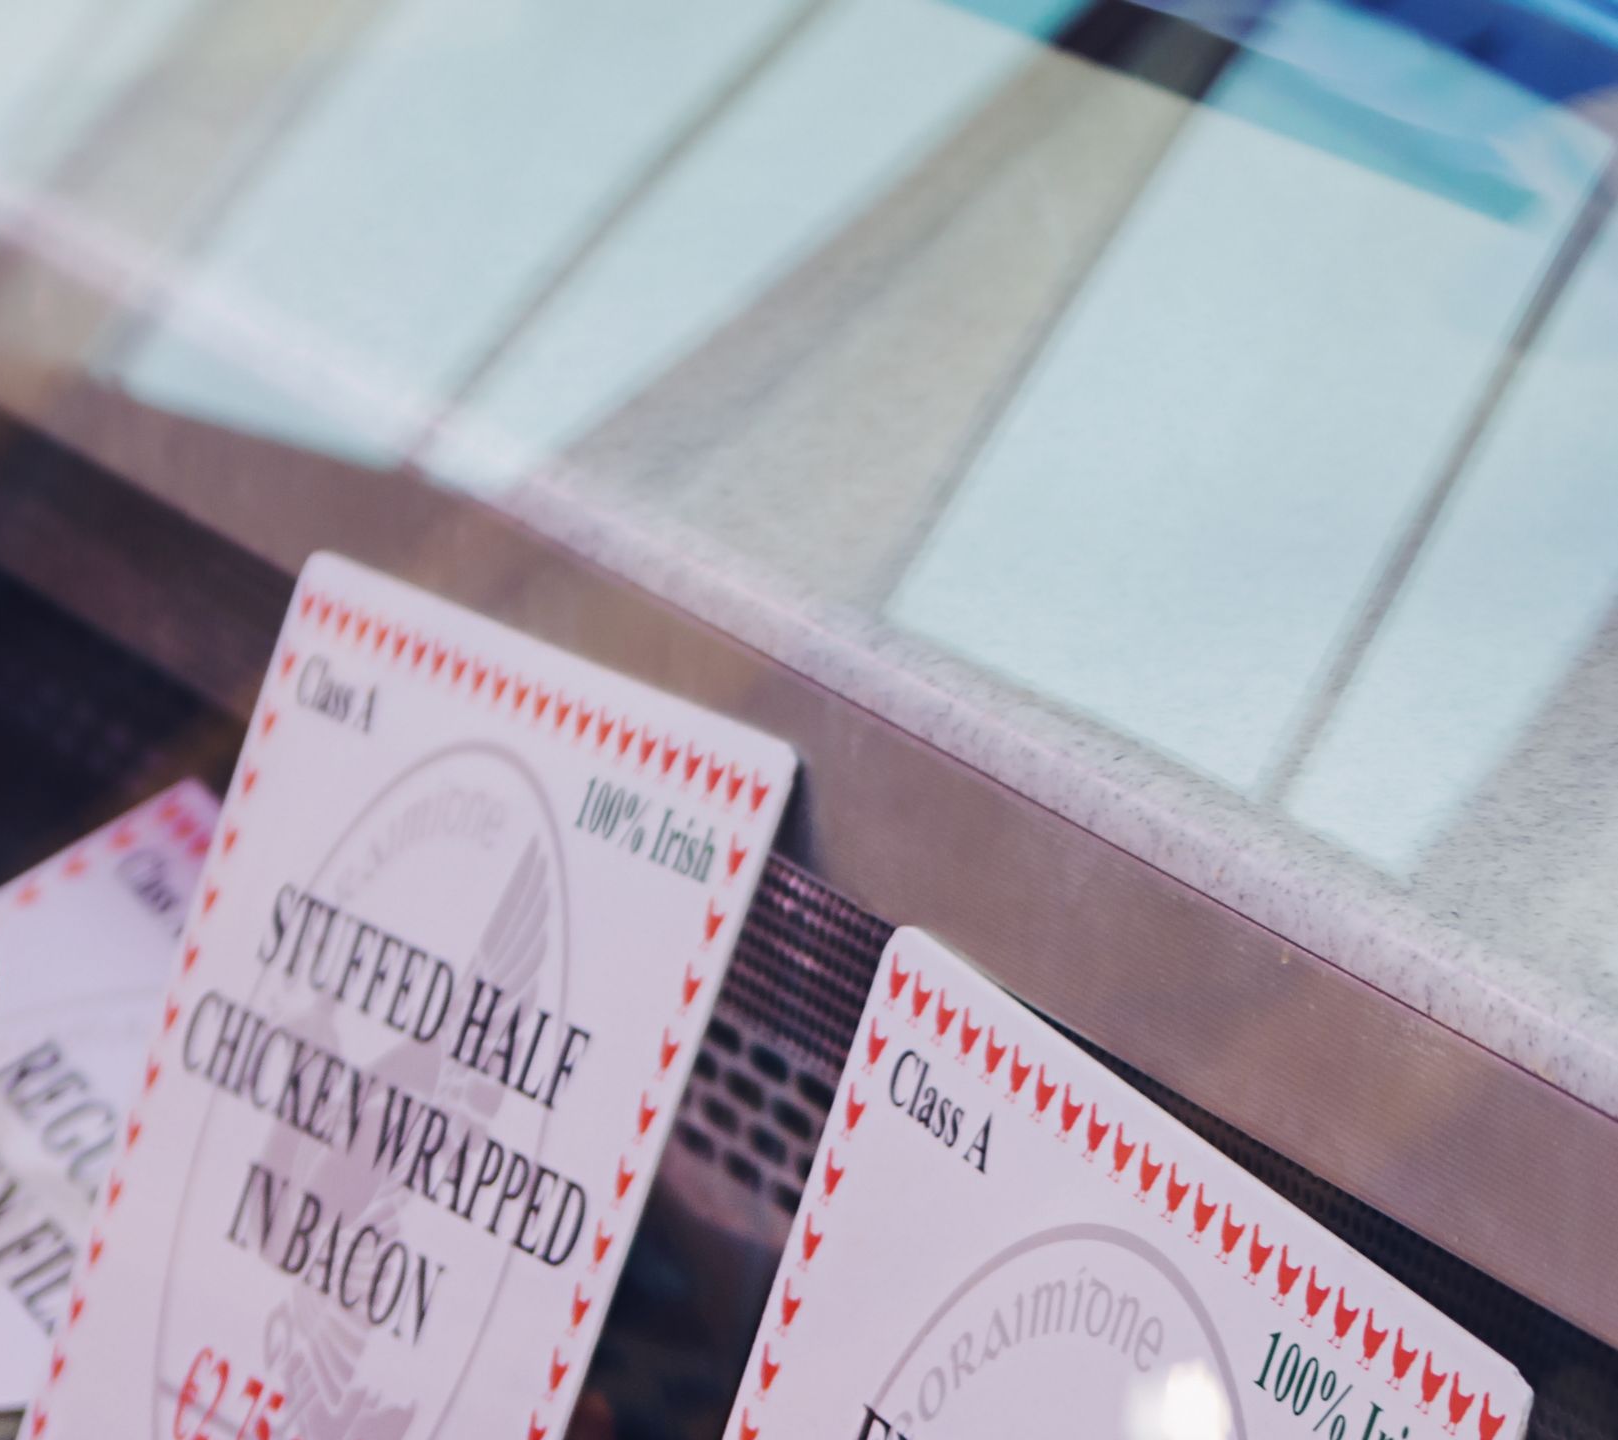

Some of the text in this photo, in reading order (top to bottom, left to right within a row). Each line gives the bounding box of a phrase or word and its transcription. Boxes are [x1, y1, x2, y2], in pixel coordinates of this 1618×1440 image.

[294, 653, 380, 736] Class A
[573, 776, 645, 854] 100%
[648, 806, 716, 883] Irish
[260, 885, 591, 1111] STUFFED HALF
[181, 991, 586, 1267] CHICKEN WRAPPED
[890, 1050, 991, 1174] Class A
[226, 1162, 444, 1346] IN BACON
